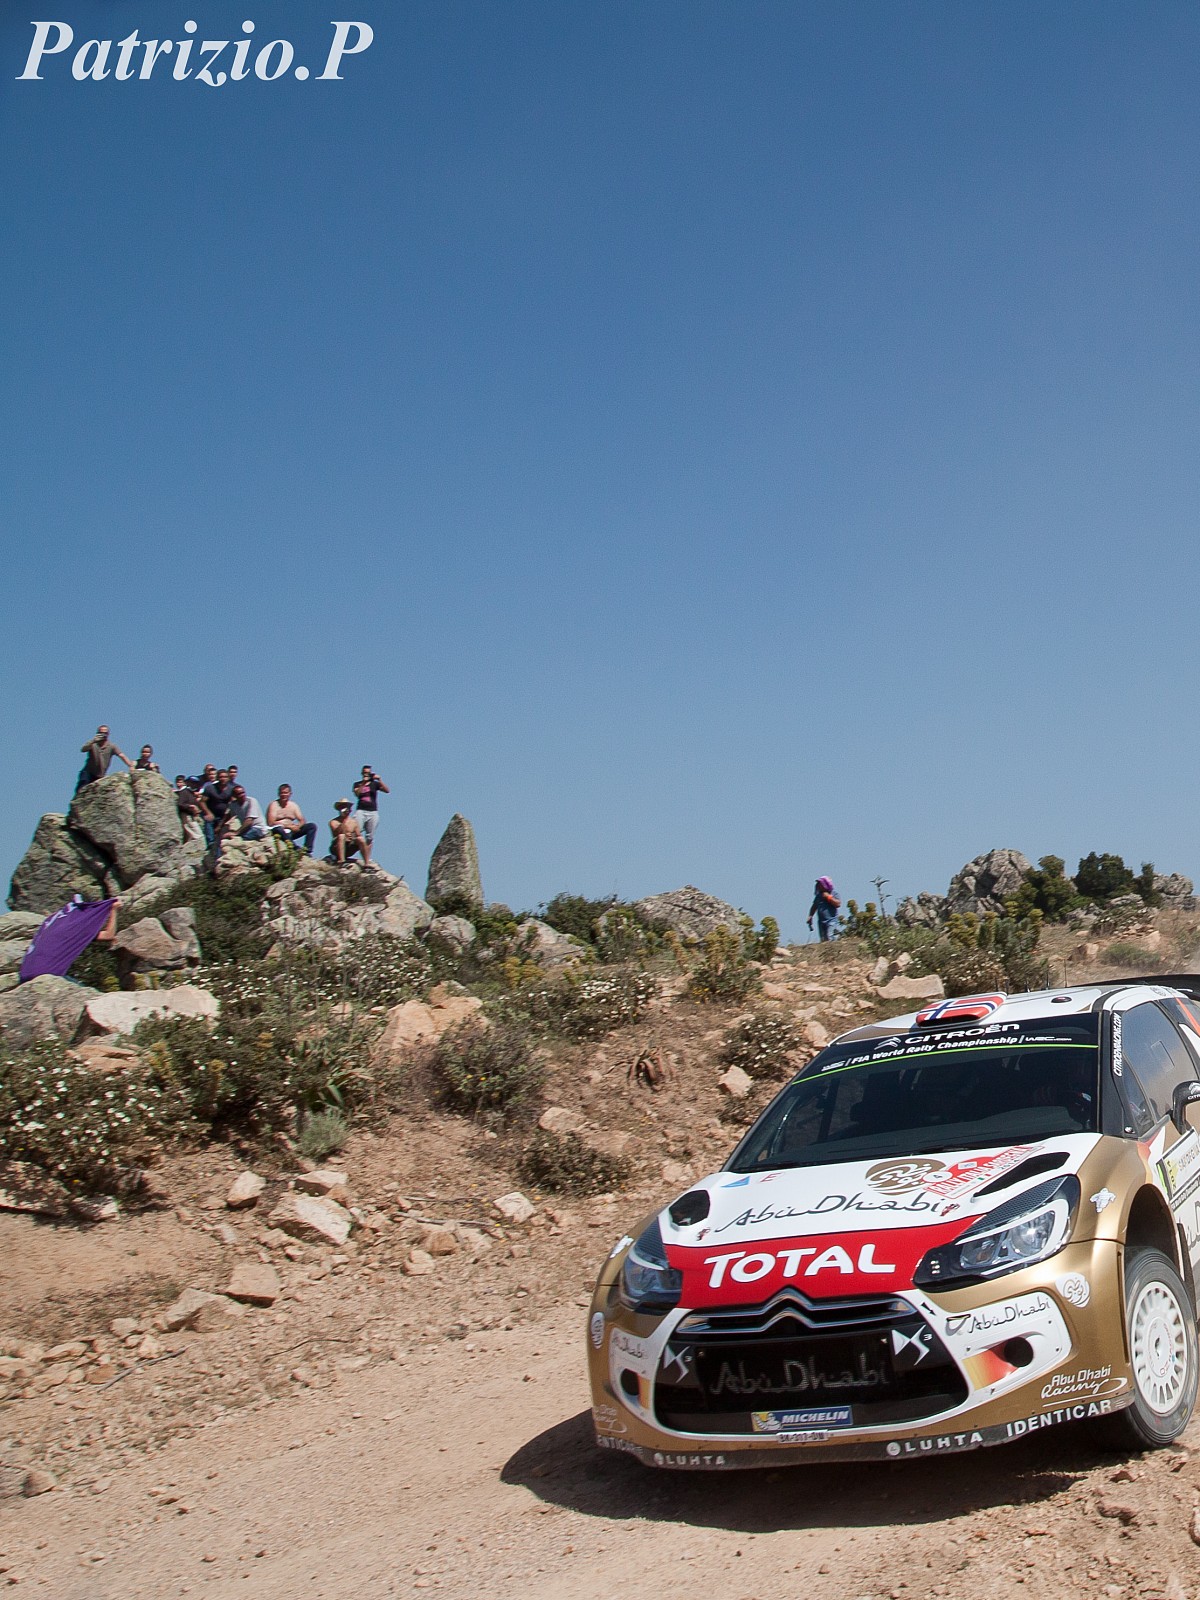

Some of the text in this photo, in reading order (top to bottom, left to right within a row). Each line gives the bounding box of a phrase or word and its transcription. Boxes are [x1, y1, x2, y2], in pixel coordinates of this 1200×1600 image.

[851, 1055, 870, 1064] FIA
[872, 1048, 904, 1060] World
[906, 1044, 934, 1054] Rally
[937, 1036, 1018, 1049] Championship
[703, 1244, 896, 1288] TOTAL
[1052, 1365, 1111, 1387] Abu Dhabi
[1041, 1379, 1105, 1399] Racing
[782, 1411, 849, 1424] MICHELIN
[1006, 1400, 1112, 1437] IDENTICAR
[905, 1432, 983, 1452] LUHTA
[666, 1455, 726, 1465] LUHTA
